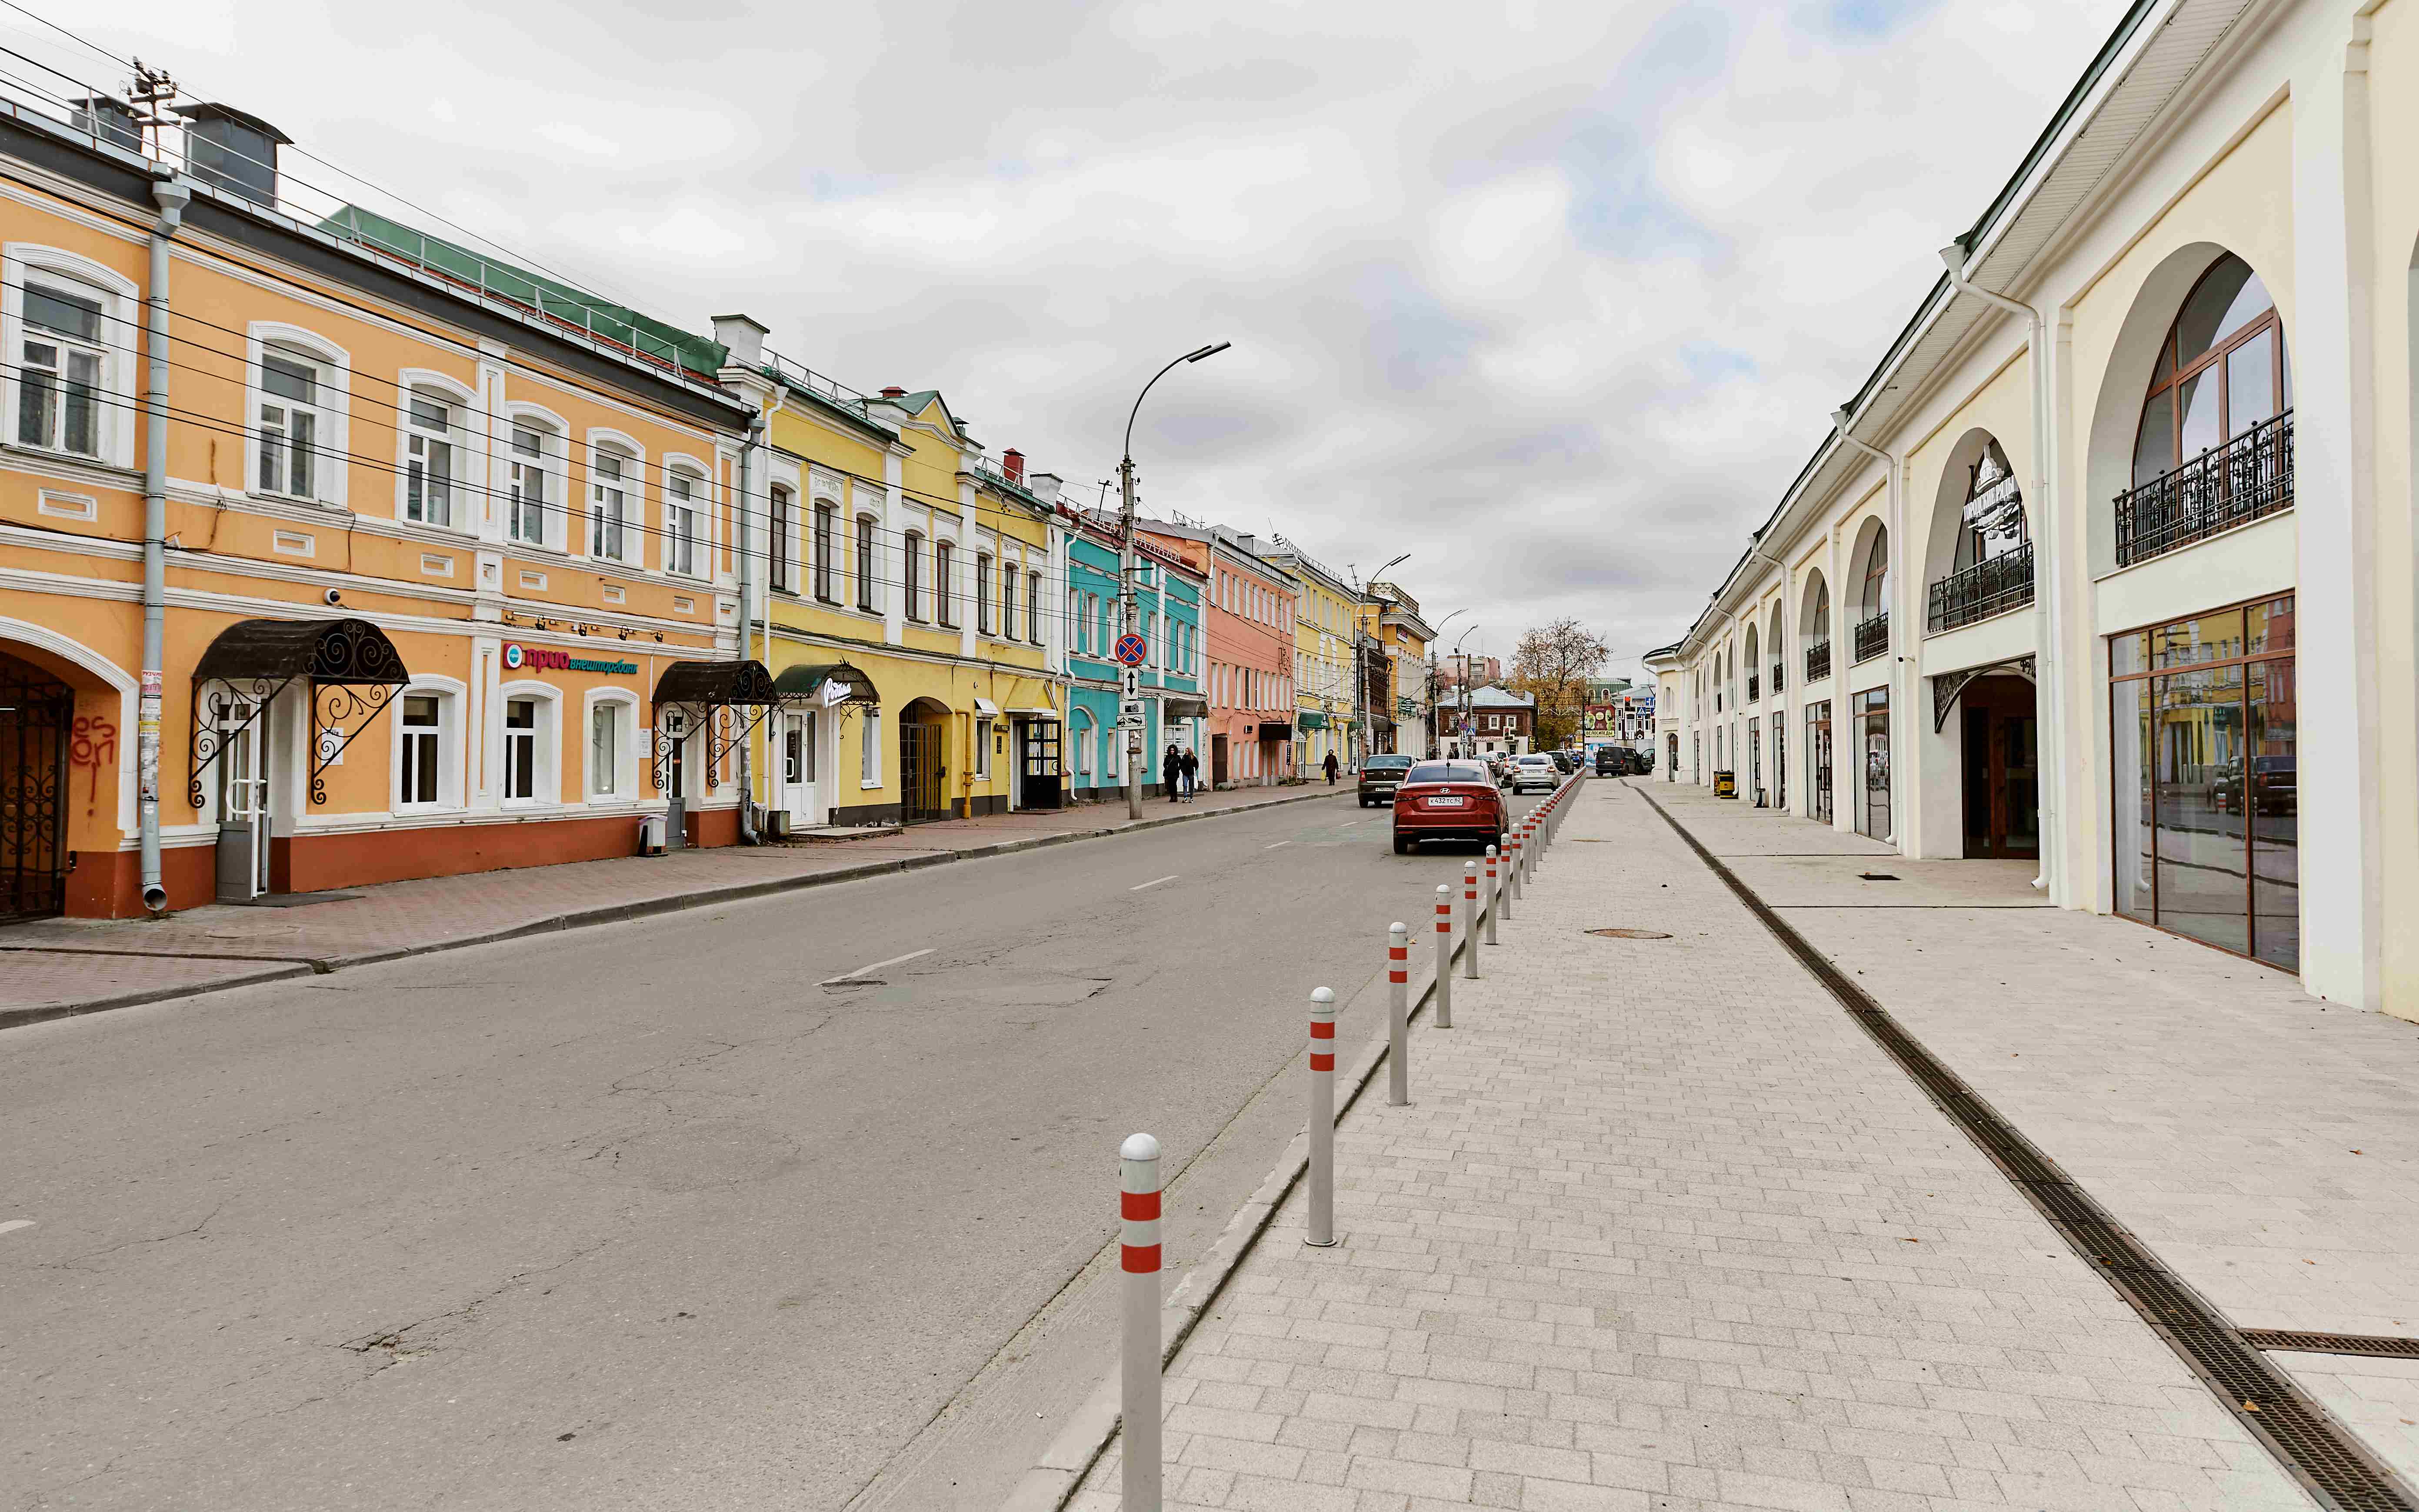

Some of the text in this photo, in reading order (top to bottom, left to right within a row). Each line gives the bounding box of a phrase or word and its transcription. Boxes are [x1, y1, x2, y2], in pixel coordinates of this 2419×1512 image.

[1963, 486, 1996, 522] ГОРОДСКИЕ
[1996, 475, 2014, 502] РЯДЫ
[525, 649, 570, 673] прио
